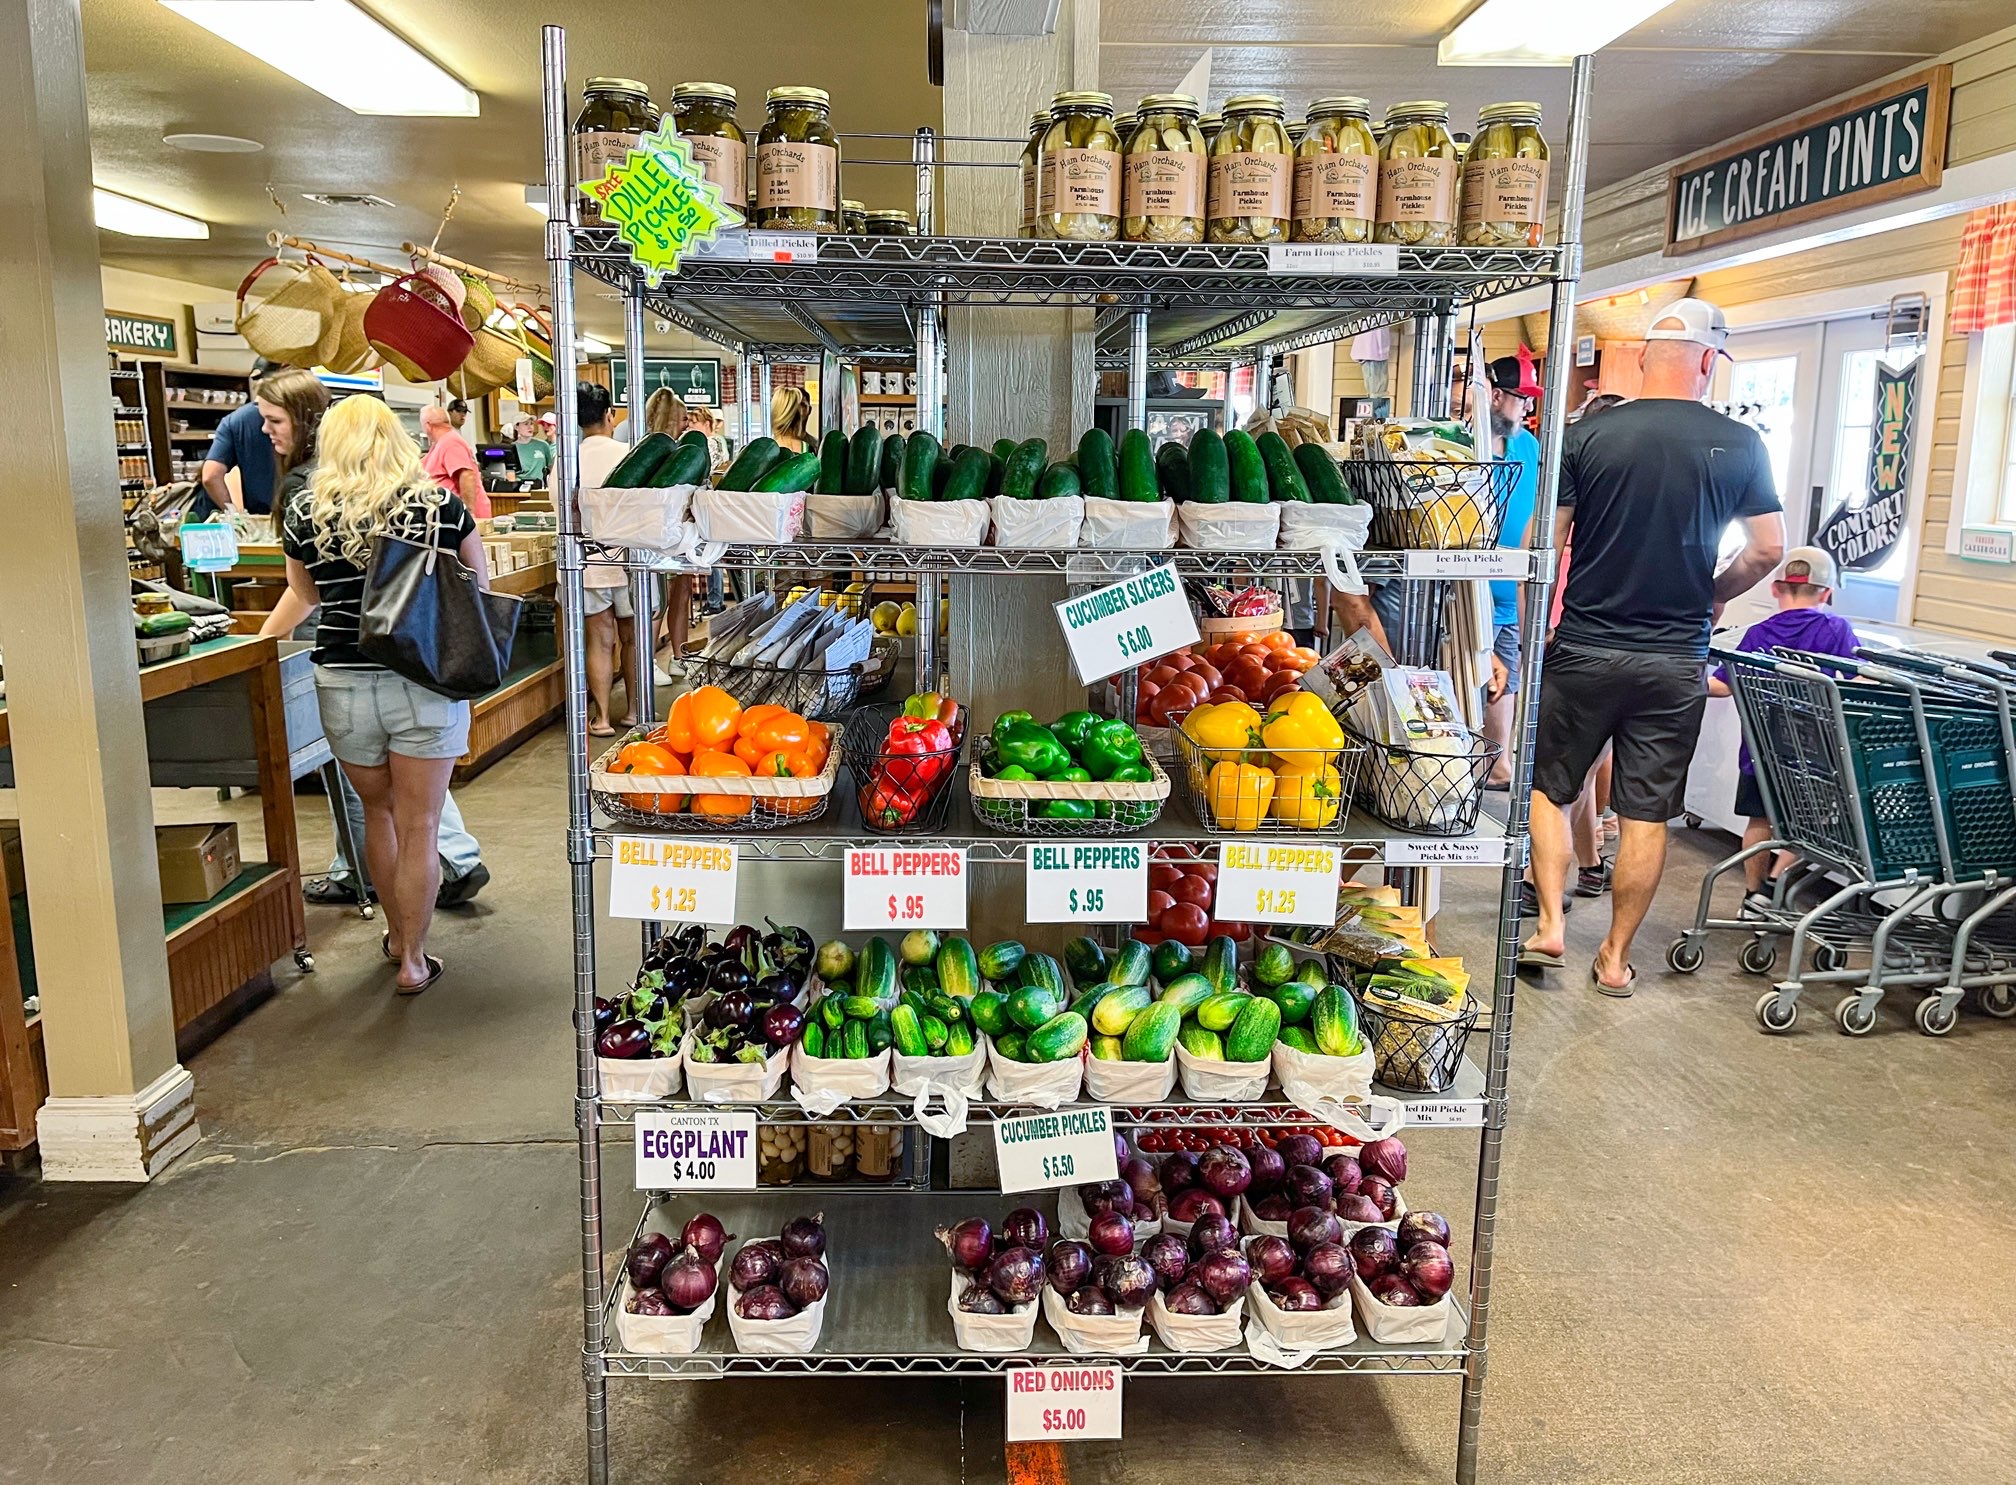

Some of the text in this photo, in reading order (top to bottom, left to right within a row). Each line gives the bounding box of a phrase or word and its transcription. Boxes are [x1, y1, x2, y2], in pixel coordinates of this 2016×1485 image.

[584, 137, 636, 154] Ham Orchar
[693, 141, 724, 158] rchards
[771, 148, 806, 163] Orchards
[1060, 152, 1113, 171] Ham Orchards
[1133, 155, 1186, 173] Ham Orchards
[1224, 156, 1278, 174] Ham Orchards
[1317, 157, 1370, 175] Ham Orchards
[1386, 161, 1442, 180] Ham Orchards
[1489, 162, 1542, 180] Ham Orchards
[1676, 97, 1920, 240] ICE CREAM PINTS
[593, 172, 623, 201] SALE
[609, 151, 682, 221] DILLED
[1069, 185, 1105, 194] Farmhouse
[1232, 189, 1269, 197] Farmhouse
[1326, 190, 1362, 198] Farmhouse
[1076, 194, 1099, 202] Pickles
[1146, 196, 1170, 204] Pickles
[1238, 197, 1263, 205] Pickles
[1332, 198, 1356, 206] Pickles
[1395, 194, 1432, 202] Farmhouse
[1401, 202, 1426, 210] Pickles
[1504, 202, 1528, 210] Pickles
[626, 176, 701, 245] PICKLES
[750, 238, 816, 248] Dilled Pickles
[1285, 247, 1383, 257] Farm House Pickles
[104, 317, 168, 348] BAKERY
[1876, 381, 1906, 491] NEW
[1827, 490, 1905, 551] COMFORT
[1838, 517, 1901, 566] COLORS
[1964, 544, 2007, 556] CASSEROLES
[1436, 554, 1504, 563] Ice Box Pickle
[1065, 568, 1176, 630] CUCUMBER SLICERS
[1126, 624, 1154, 654] 6.00
[619, 840, 732, 872] BELL PEPPERS
[1407, 842, 1481, 853] Sweet & Sassy
[851, 852, 961, 877] BELL PEPPERS
[1033, 846, 1140, 871] BELL PEPPERS
[1225, 844, 1334, 874] BELL PEPPERS
[650, 885, 697, 913] $ 1.25
[888, 894, 924, 922] $ .95
[1069, 887, 1104, 914] $ .95
[1256, 887, 1297, 916] $1.25
[1421, 1105, 1438, 1113] Dill
[1440, 1105, 1467, 1113] Pickle
[670, 1117, 720, 1126] CANTON TX
[1001, 1110, 1107, 1144] CUCUMBER PICKLES
[643, 1129, 749, 1160] EGGPLANT
[673, 1160, 716, 1182] $ 4.00
[1042, 1154, 1075, 1181] $ 5.50
[1013, 1369, 1115, 1393] RED ONIONS
[1042, 1408, 1086, 1434] $5.00
